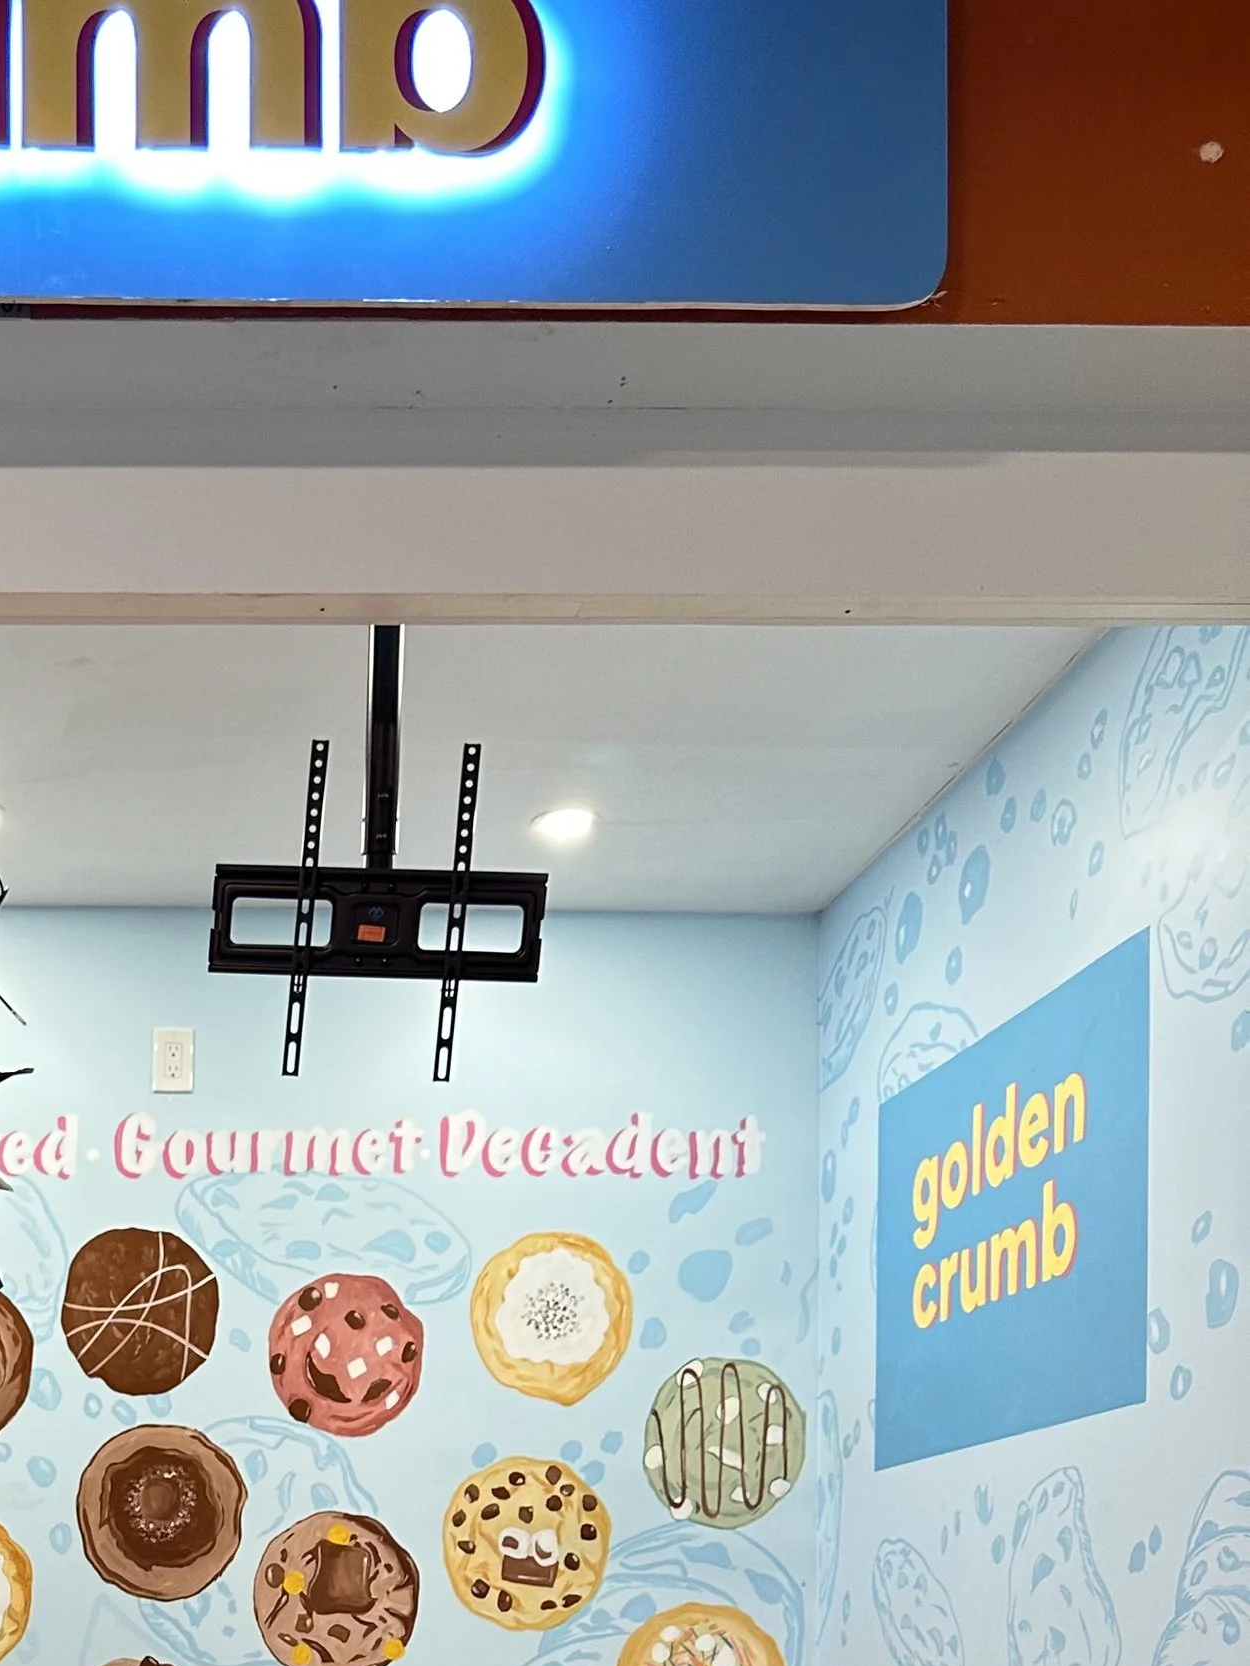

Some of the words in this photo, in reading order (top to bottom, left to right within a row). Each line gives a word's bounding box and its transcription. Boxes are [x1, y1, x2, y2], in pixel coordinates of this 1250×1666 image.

[114, 1111, 424, 1180] Gourmet
[439, 1109, 766, 1180] Decadent
[912, 1072, 1087, 1250] golden
[911, 1179, 1079, 1330] crumb
